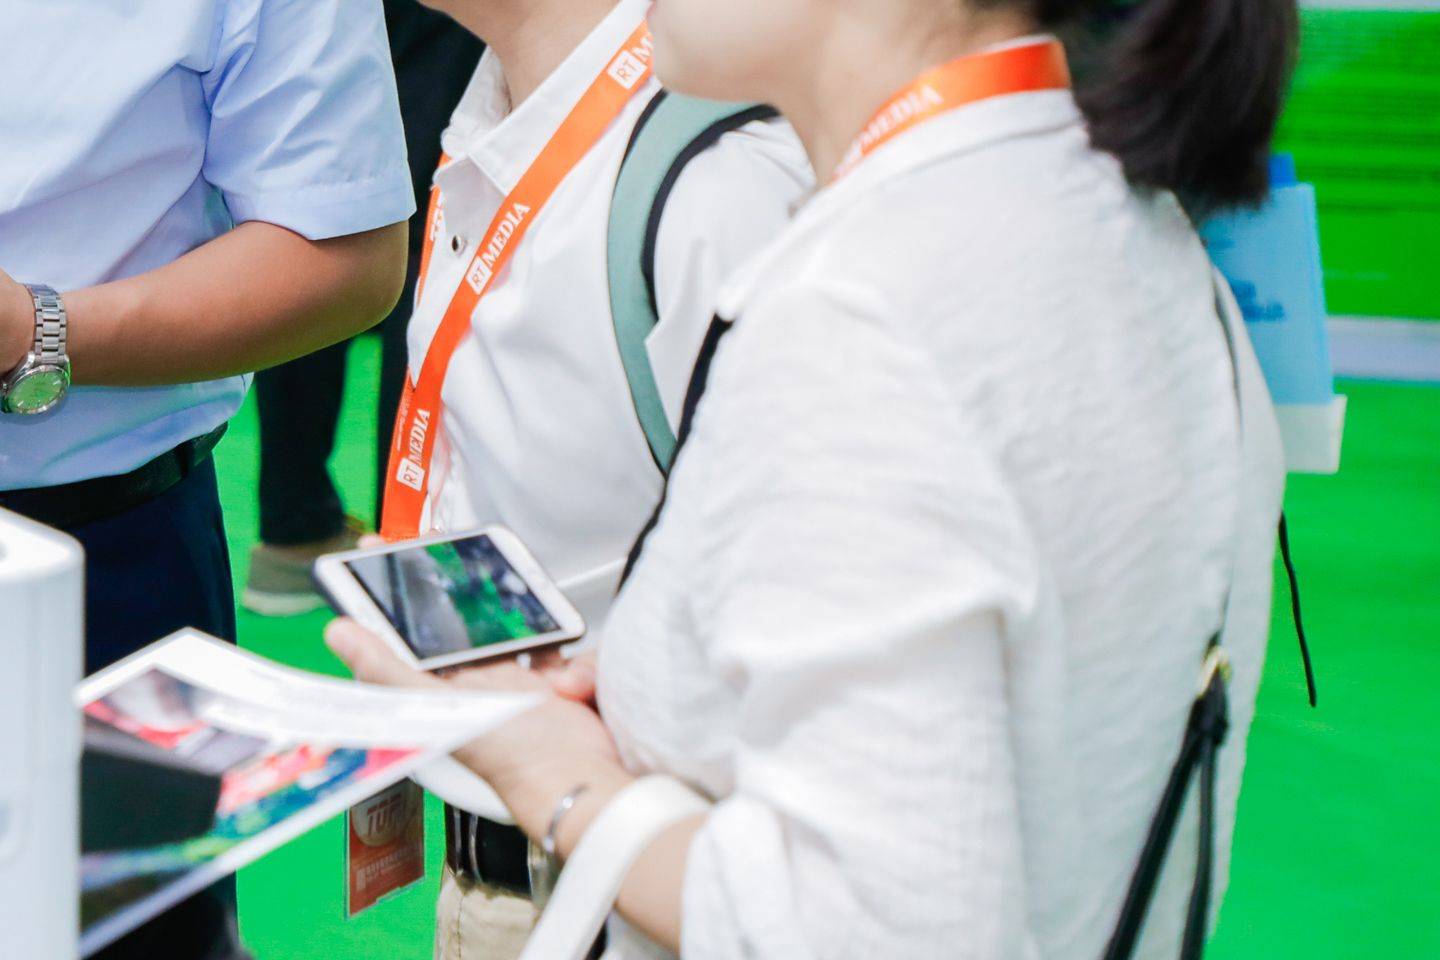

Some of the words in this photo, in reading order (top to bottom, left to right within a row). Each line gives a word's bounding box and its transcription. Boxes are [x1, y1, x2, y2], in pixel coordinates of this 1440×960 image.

[482, 203, 531, 269] MEDIA
[408, 408, 430, 469] MEDIA
[400, 460, 421, 487] RT
